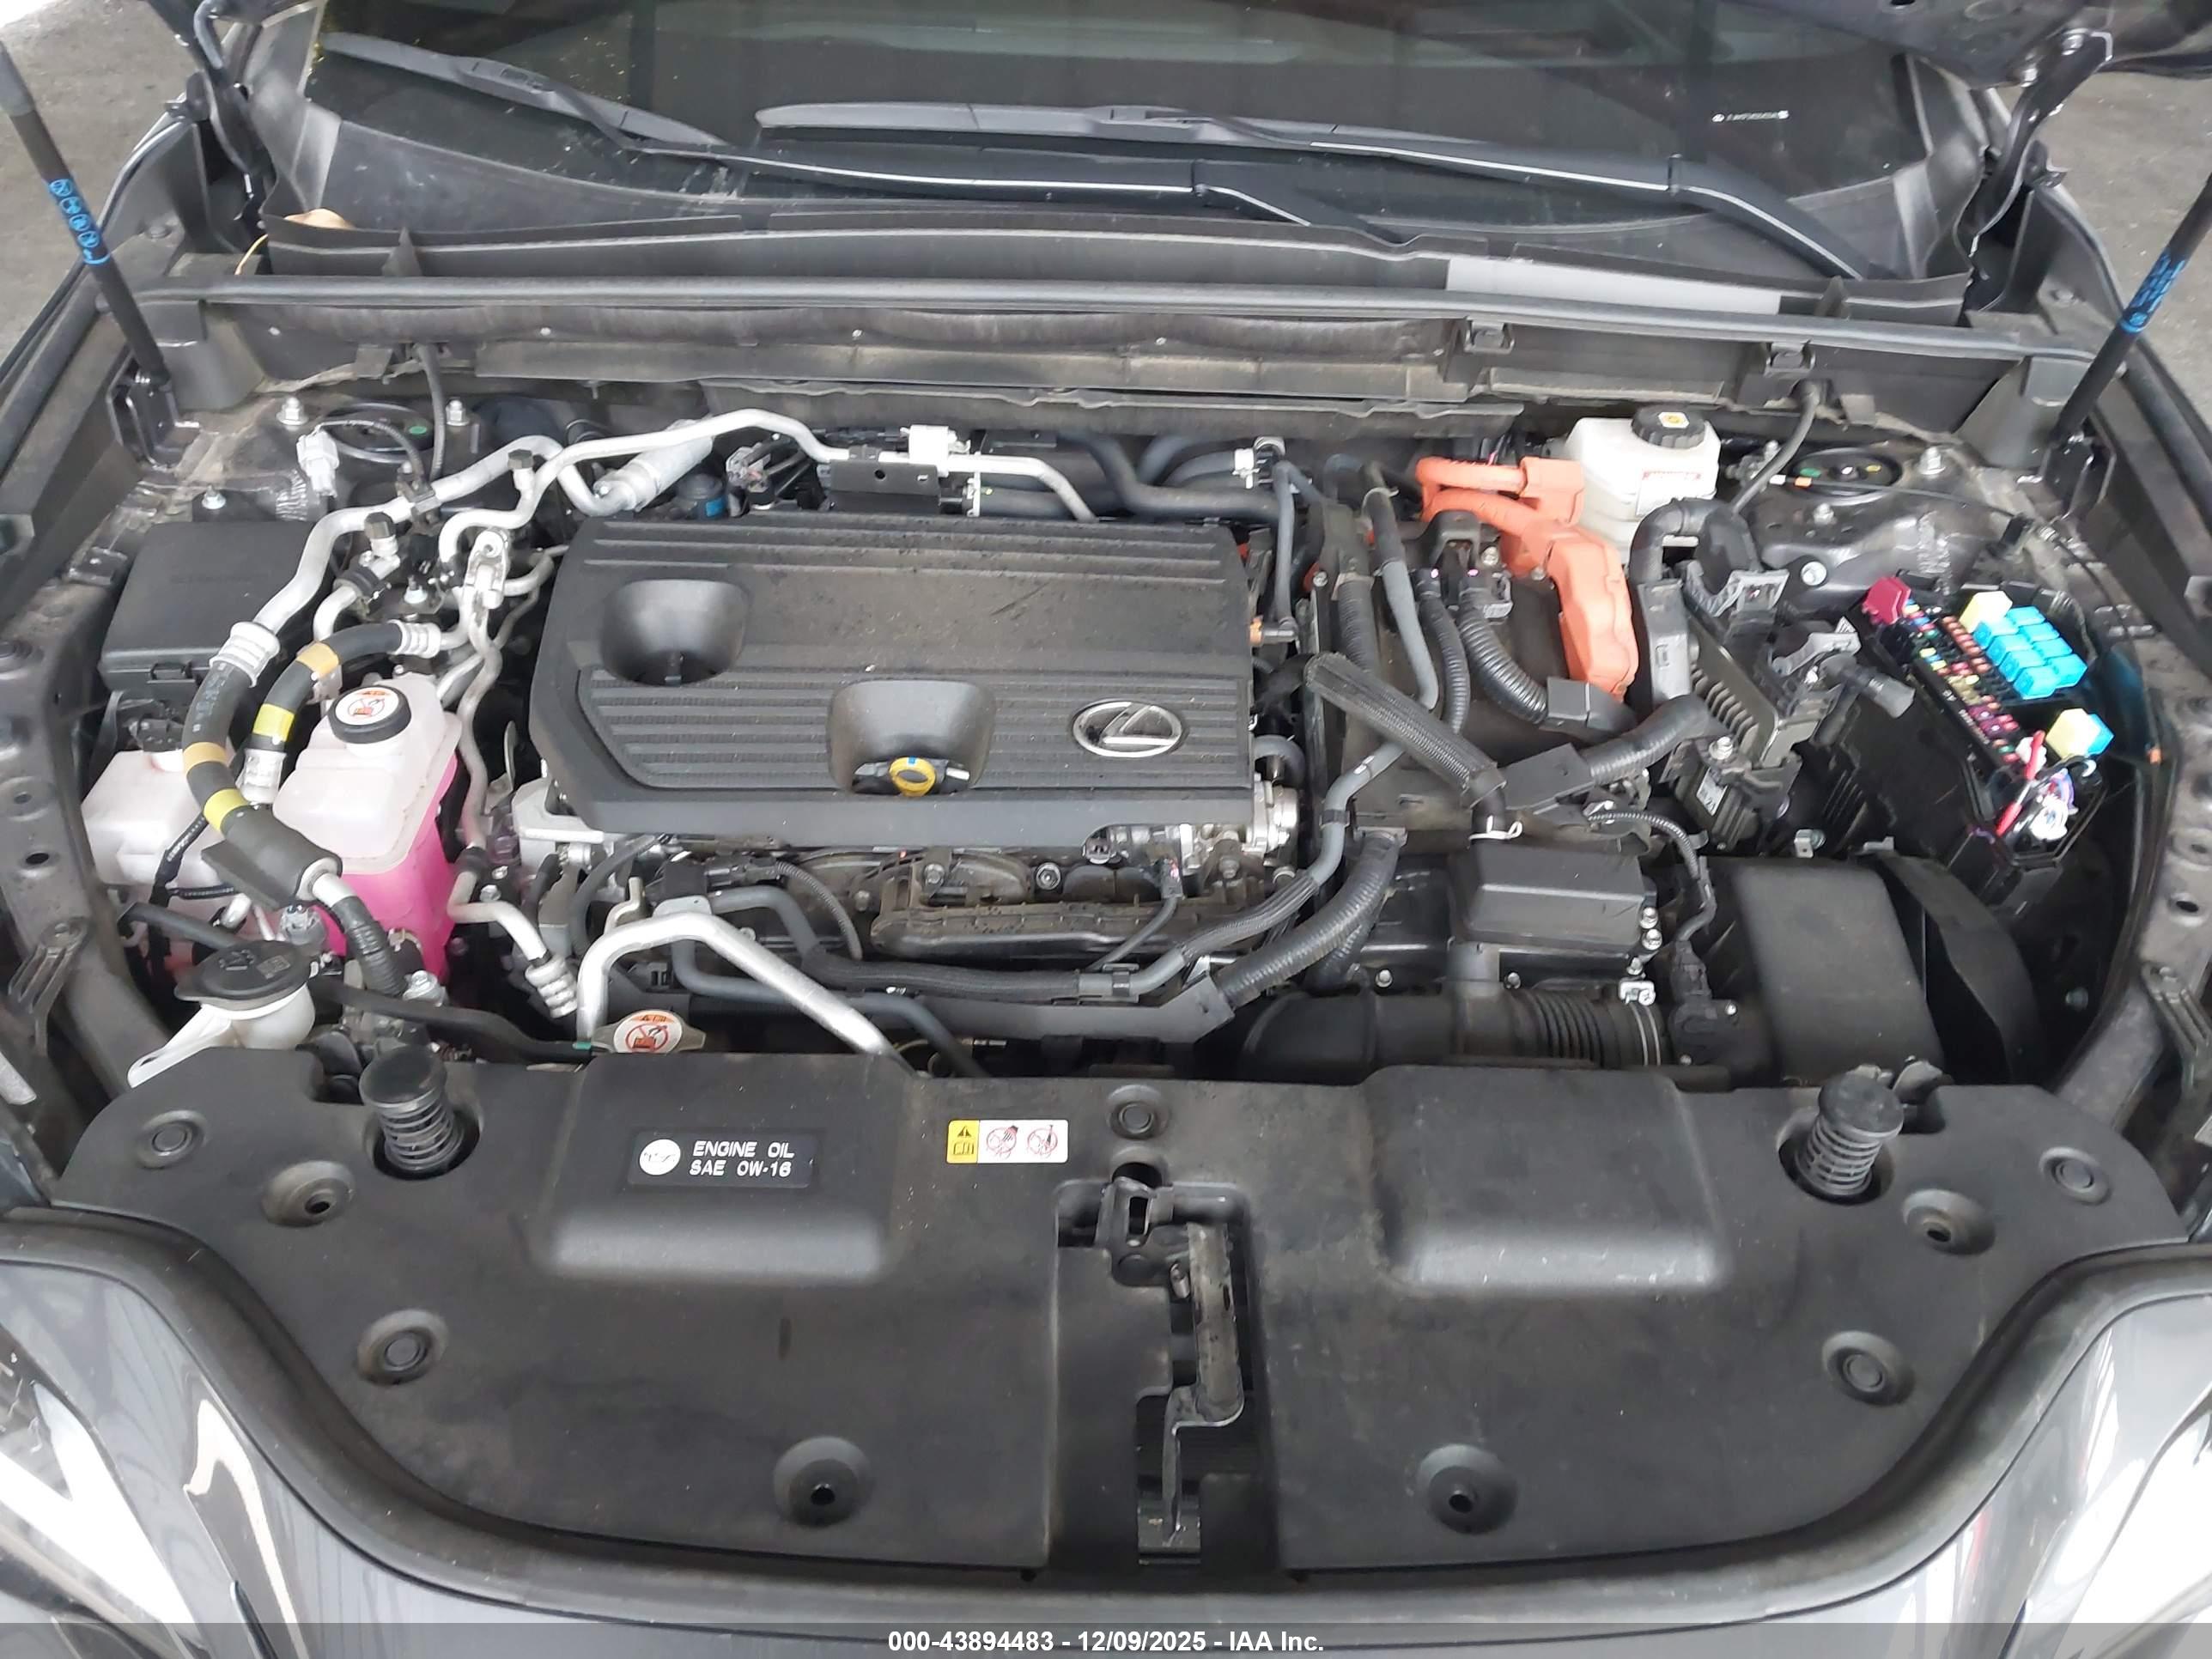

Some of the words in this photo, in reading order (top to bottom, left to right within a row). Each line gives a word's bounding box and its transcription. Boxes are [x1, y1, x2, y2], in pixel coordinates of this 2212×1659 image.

[692, 1140, 757, 1158] ENGINE
[768, 1142, 795, 1158] OIL
[689, 1159, 727, 1176] SAE
